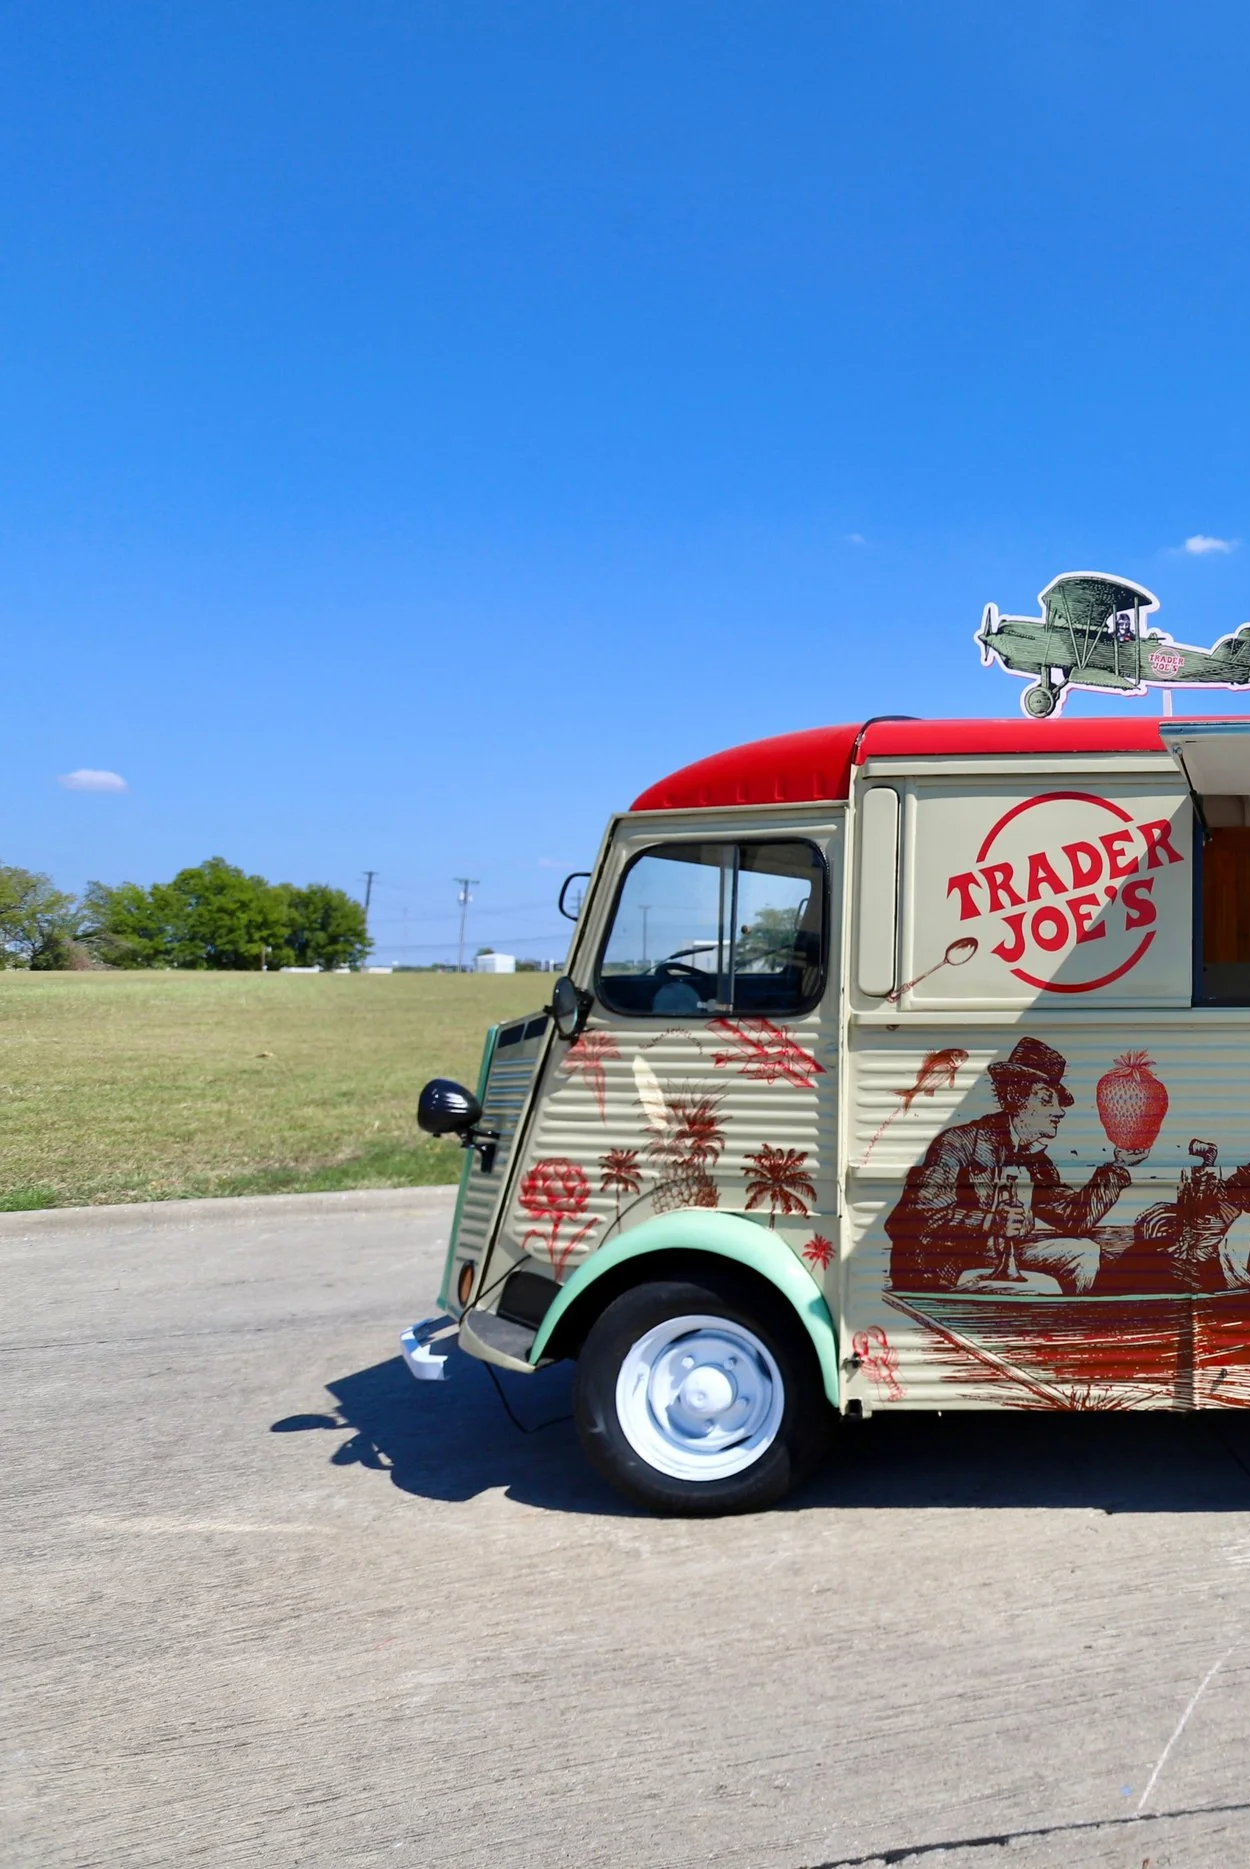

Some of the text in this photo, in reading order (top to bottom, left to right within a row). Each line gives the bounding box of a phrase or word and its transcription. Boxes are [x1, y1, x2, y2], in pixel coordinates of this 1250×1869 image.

[1150, 654, 1184, 664] TRADER
[946, 819, 1184, 921] TRADER
[990, 876, 1157, 963] JOE'S
